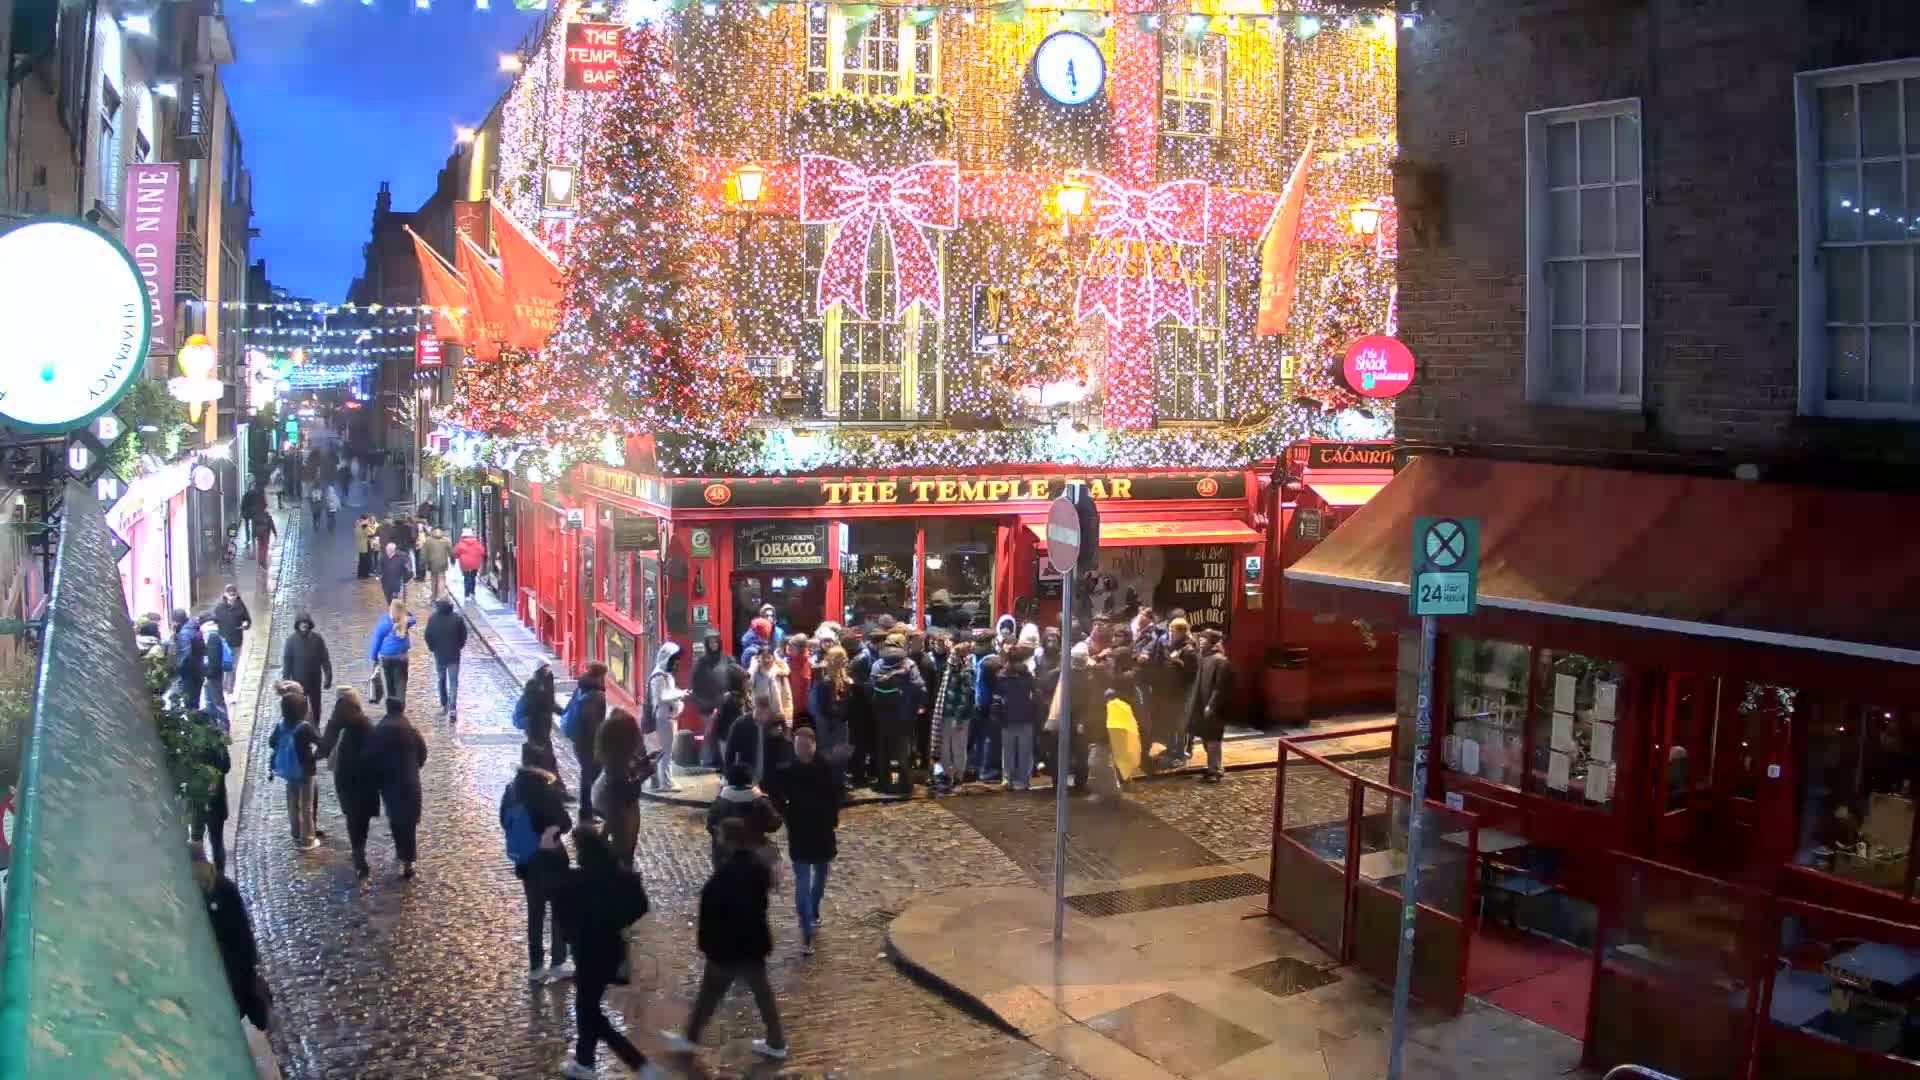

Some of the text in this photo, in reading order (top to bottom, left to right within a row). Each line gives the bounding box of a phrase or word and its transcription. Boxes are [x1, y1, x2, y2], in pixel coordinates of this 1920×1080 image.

[584, 29, 617, 45] THE
[136, 171, 169, 232] NINE
[1088, 236, 1181, 263] MERRY
[1065, 259, 1206, 288] CHRISTMAS
[823, 478, 1132, 502] THE TEMPLE AR
[752, 541, 816, 562] TOBACCO
[1203, 563, 1225, 577] THE
[1175, 578, 1225, 593] EMPEROR
[1421, 585, 1442, 602] 24
[1211, 593, 1225, 607] OF
